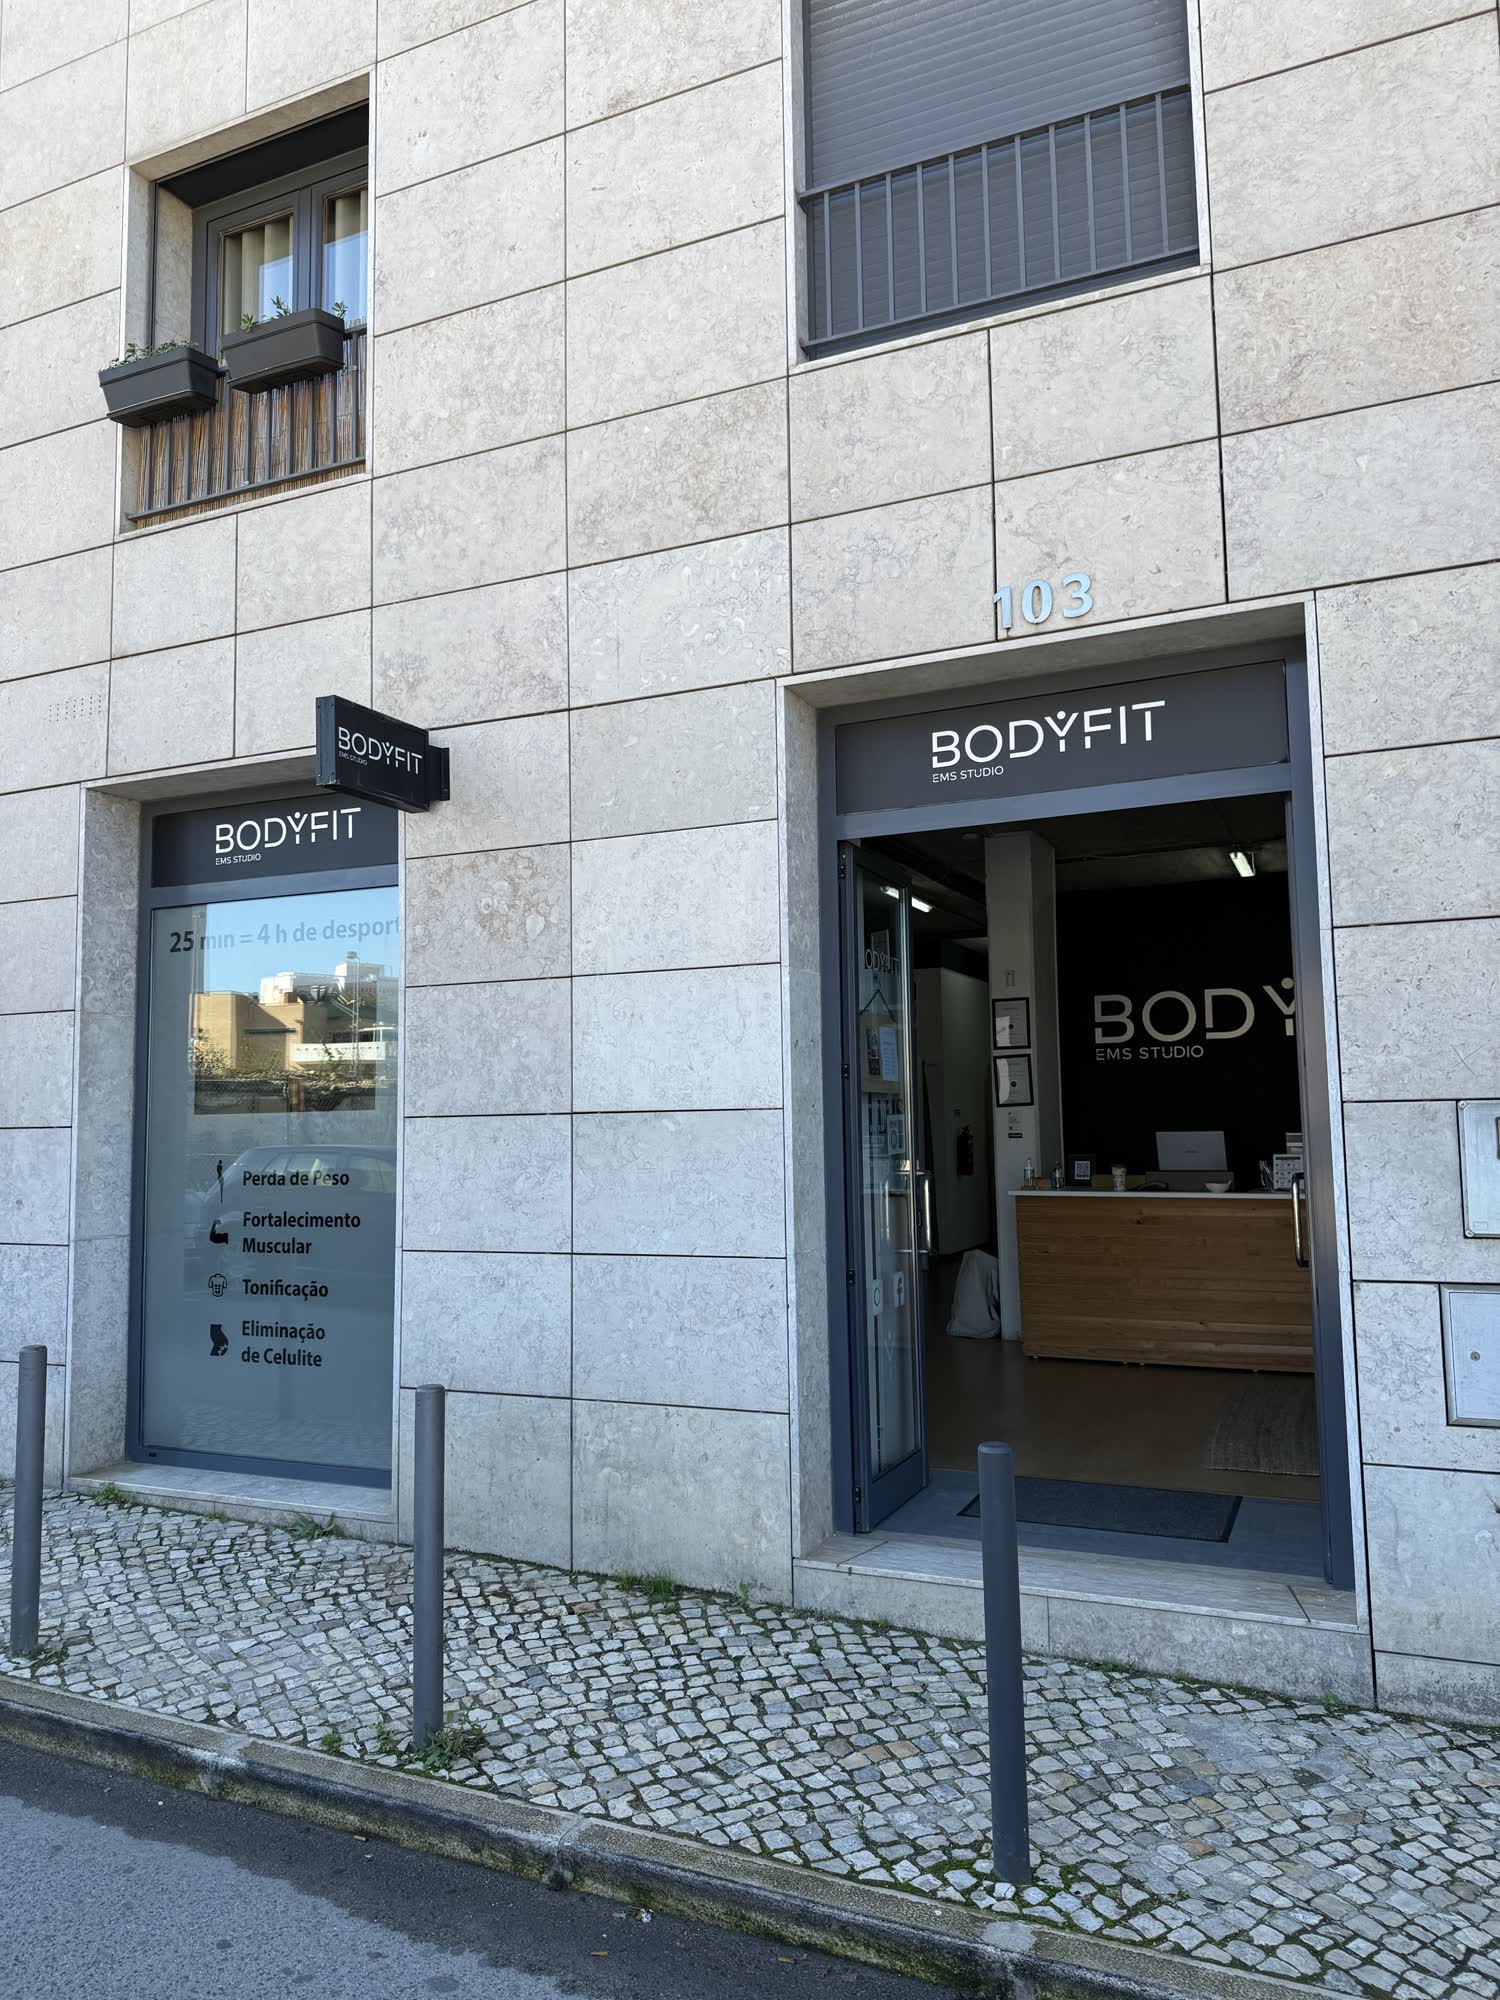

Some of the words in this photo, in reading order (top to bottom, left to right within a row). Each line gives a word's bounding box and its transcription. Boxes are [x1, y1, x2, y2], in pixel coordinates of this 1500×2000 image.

[993, 573, 1094, 629] 103
[931, 700, 1166, 769] BODYFIT
[338, 726, 423, 775] BODYFIT
[932, 771, 957, 783] EMS
[960, 765, 1004, 780] STUDIO
[215, 807, 361, 854] BODYFIT
[215, 857, 232, 866] EMS
[233, 853, 262, 863] STUDIO
[169, 930, 194, 953] 25
[200, 933, 235, 950] min
[257, 923, 271, 945] 4
[276, 923, 287, 944] h
[293, 922, 317, 942] de
[1096, 1048, 1132, 1061] EMS
[1139, 1045, 1204, 1060] STUDIO
[242, 1170, 285, 1187] Perda
[290, 1170, 309, 1186] de
[313, 1171, 350, 1186] Peso
[242, 1211, 361, 1229] Fortalecimento
[242, 1236, 312, 1254] Muscular
[242, 1278, 329, 1301] Tonificação
[241, 1320, 326, 1343] Eliminação
[241, 1346, 260, 1364] de
[263, 1348, 322, 1367] Celulite
